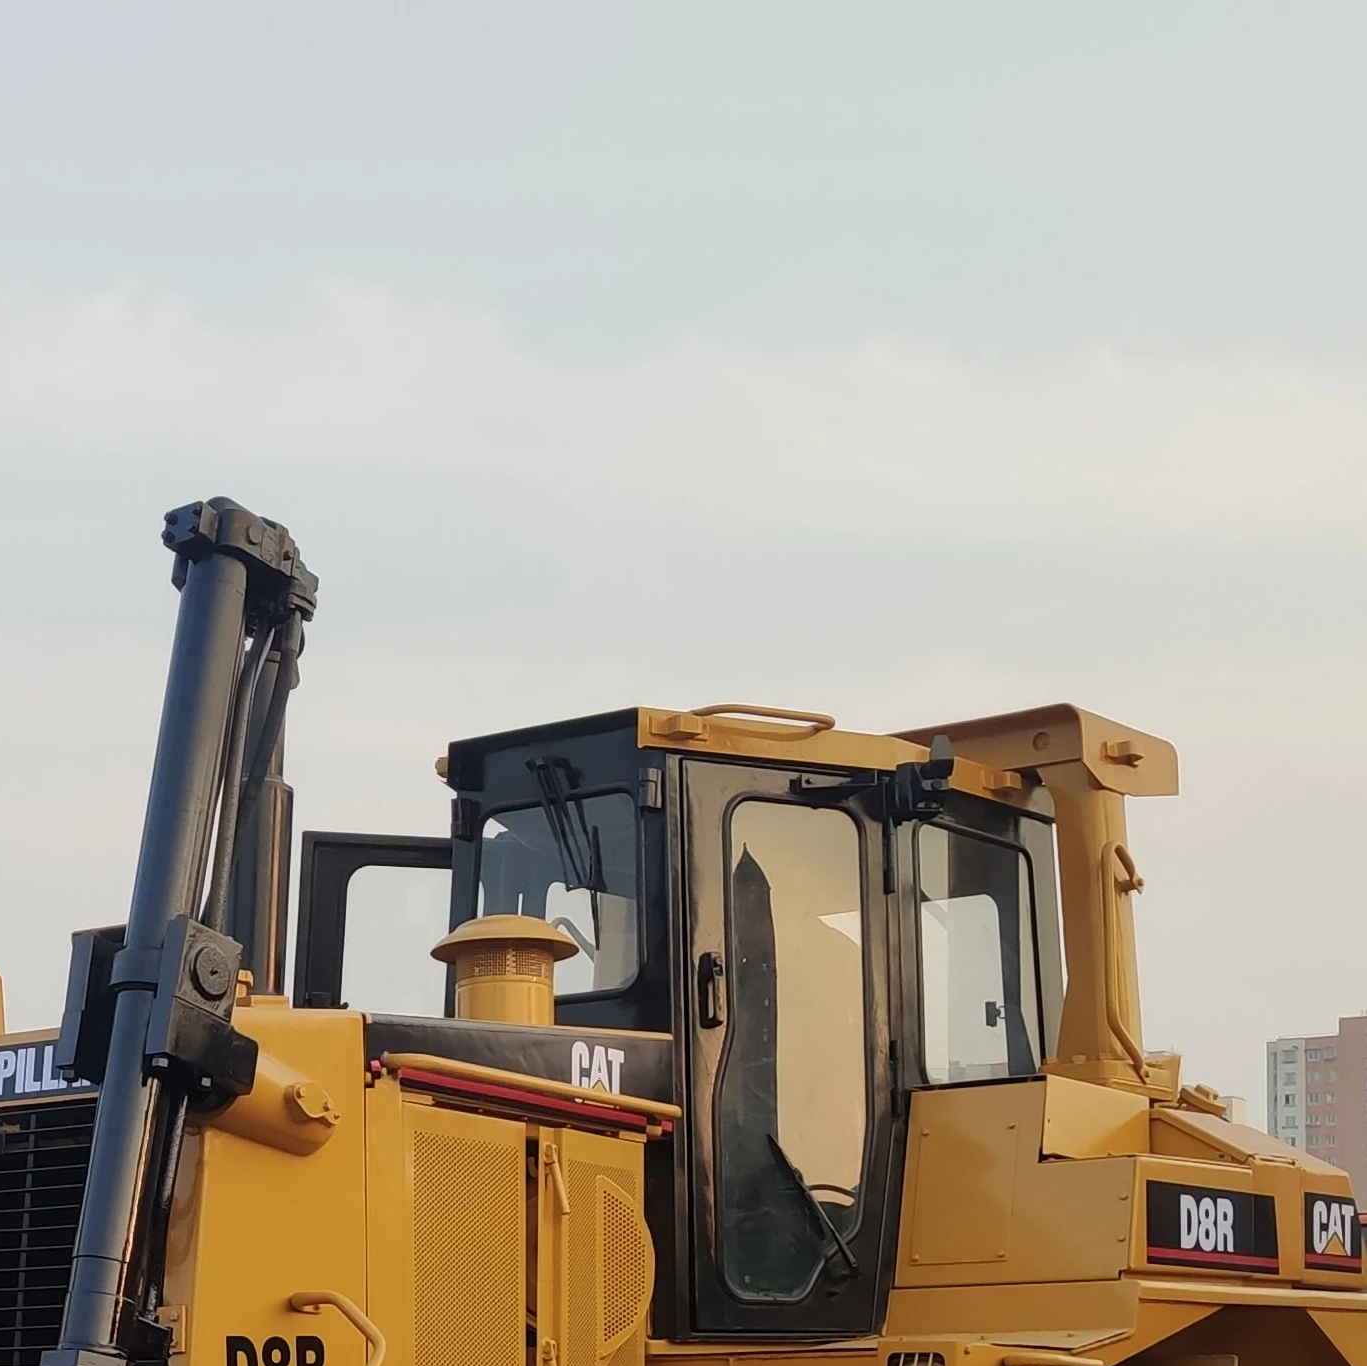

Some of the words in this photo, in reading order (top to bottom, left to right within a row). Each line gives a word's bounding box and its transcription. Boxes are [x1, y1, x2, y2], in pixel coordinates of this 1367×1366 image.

[571, 1041, 625, 1110] CAT
[1180, 1194, 1234, 1252] D8R
[1313, 1200, 1354, 1256] CAT
